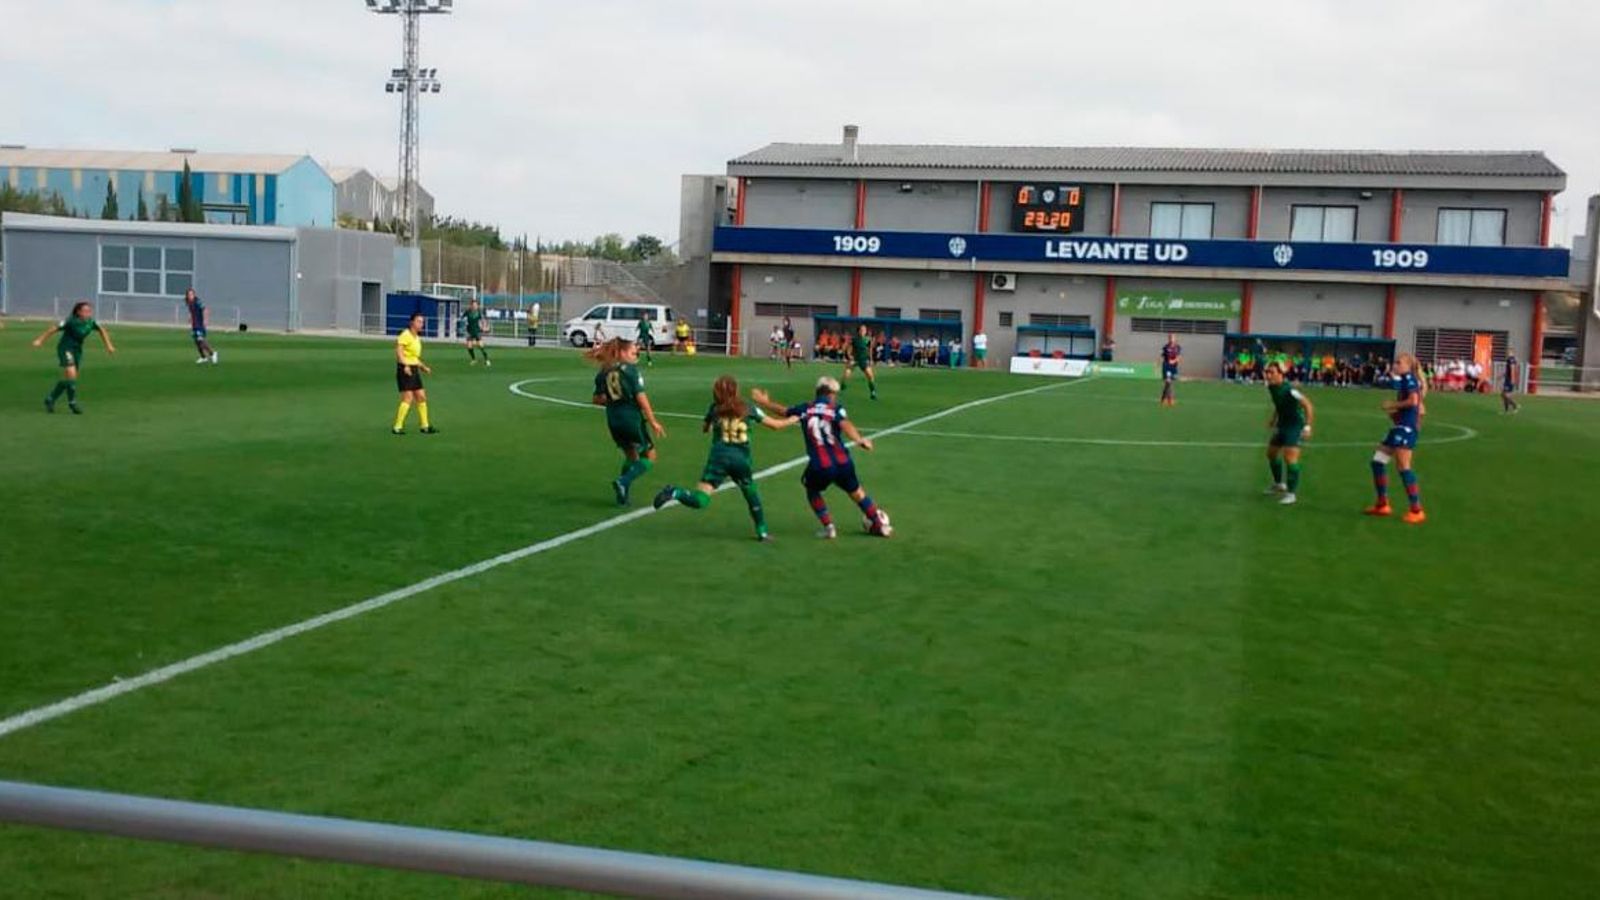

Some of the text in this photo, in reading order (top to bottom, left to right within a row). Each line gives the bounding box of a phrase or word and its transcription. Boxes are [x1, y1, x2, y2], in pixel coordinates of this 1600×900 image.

[833, 235, 880, 252] 1909
[1045, 240, 1188, 261] LEVANTE UD
[1372, 249, 1429, 268] 1909
[807, 416, 835, 446] 11
